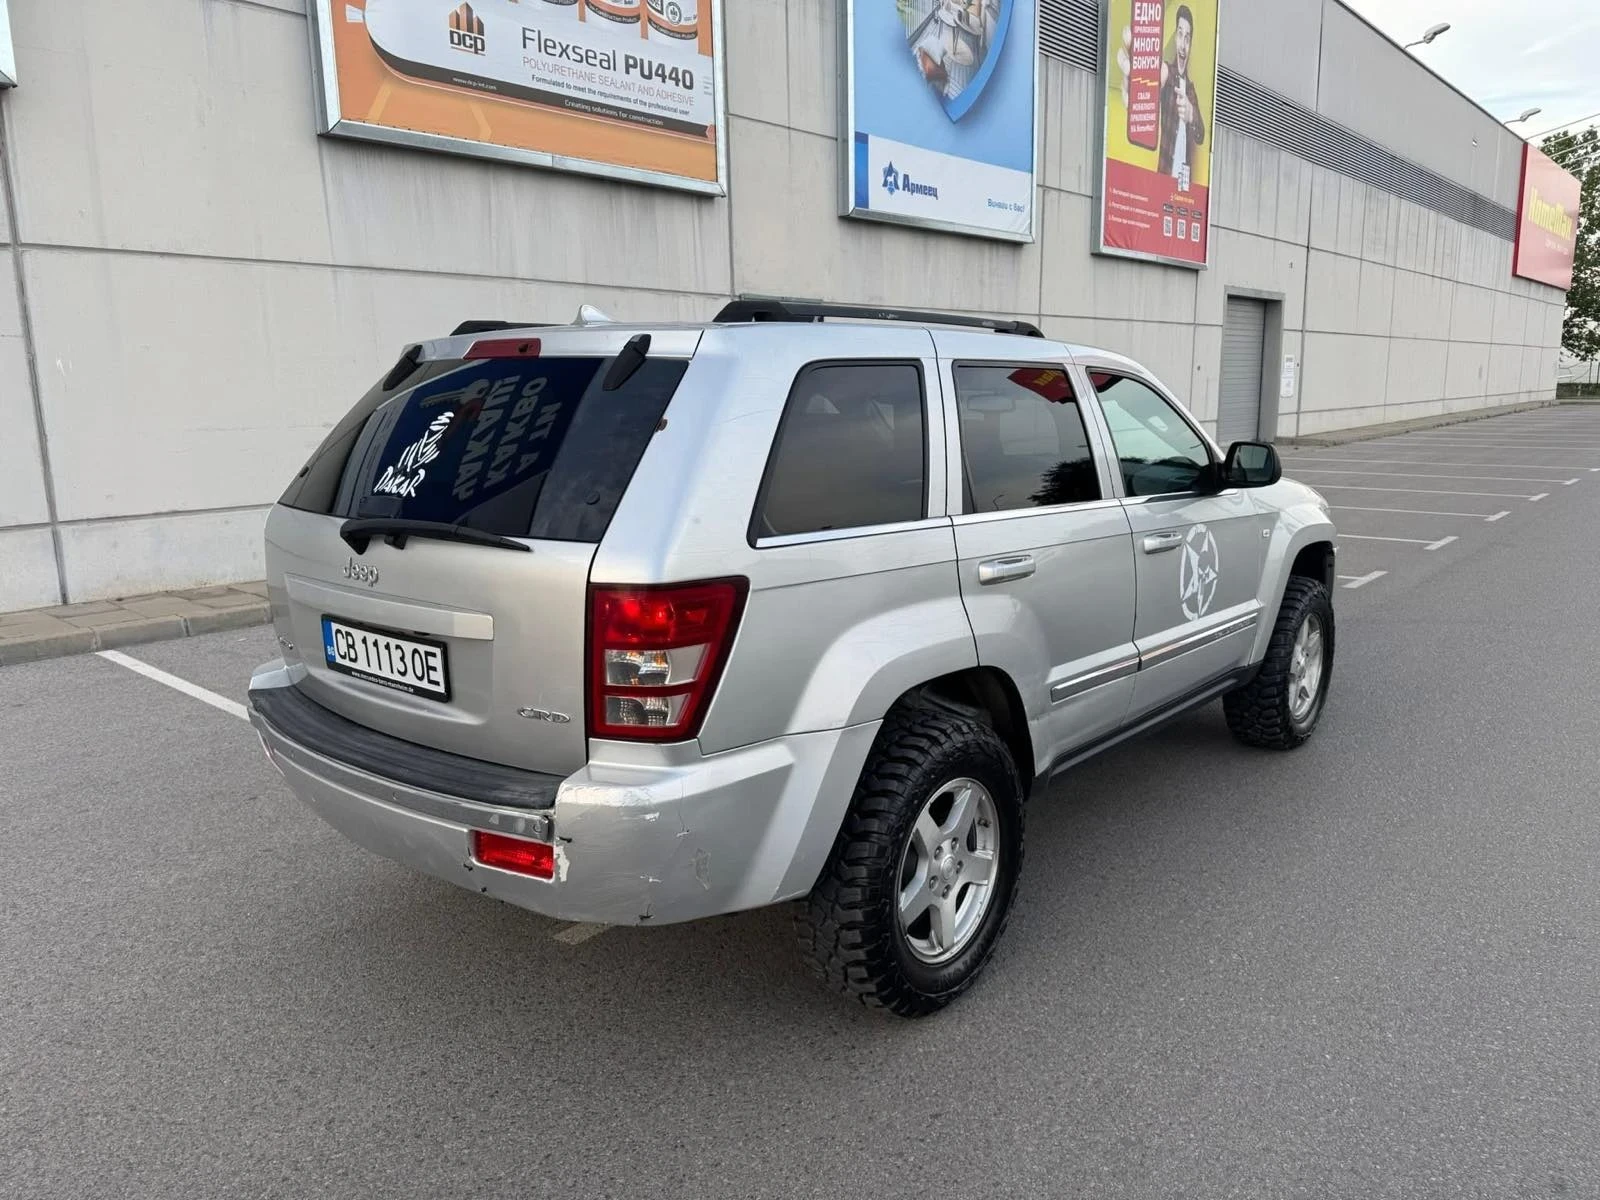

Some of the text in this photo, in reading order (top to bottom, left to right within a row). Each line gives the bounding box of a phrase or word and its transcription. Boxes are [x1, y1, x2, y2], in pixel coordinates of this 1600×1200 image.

[1134, 2, 1162, 24] ЕДНО
[522, 27, 617, 72] Flexseal
[624, 53, 694, 90] PU440
[1133, 37, 1160, 52] МНОГО
[1132, 55, 1160, 70] БОНУСИ
[523, 56, 695, 106] POLYURETHANE SEALANT AND ADHESIVE
[531, 74, 690, 116] Formulated to meet the requirements of the professional user
[564, 99, 664, 126] Creating solutions for construction
[902, 173, 939, 201] Армеец
[373, 465, 426, 497] DAKAR
[343, 556, 379, 588] Jeep
[335, 628, 358, 663] CB
[361, 635, 408, 677] 1113
